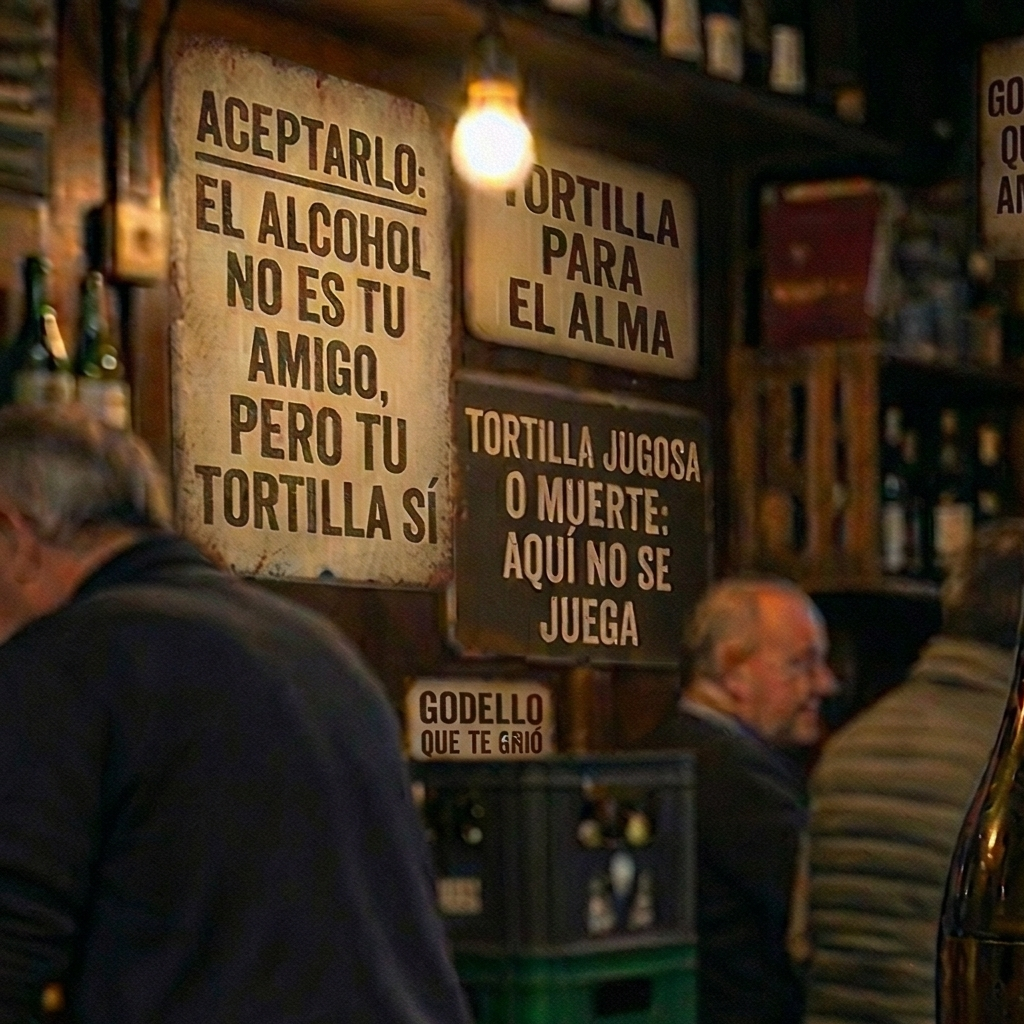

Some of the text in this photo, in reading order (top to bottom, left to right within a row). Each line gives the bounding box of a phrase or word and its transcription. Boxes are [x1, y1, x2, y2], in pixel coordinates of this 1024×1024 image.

[197, 90, 426, 198] ACEPTARLO:
[195, 173, 431, 280] EL ALCOHOL
[542, 224, 642, 296] PARA
[227, 250, 405, 338] NO ES TU
[509, 276, 674, 359] EL ALMA
[248, 326, 389, 408] AMIGO,
[229, 394, 407, 474] PERO TU
[464, 407, 701, 483] TORTILLA JUGOSA
[194, 464, 439, 544] TORTILLA SÍ
[505, 470, 669, 536] O MUERTE:
[503, 525, 672, 592] AQUÍ NO SE
[540, 596, 639, 647] JUEGA
[419, 690, 543, 726] GODELLO
[421, 729, 460, 758] QUE
[468, 730, 492, 755] TE
